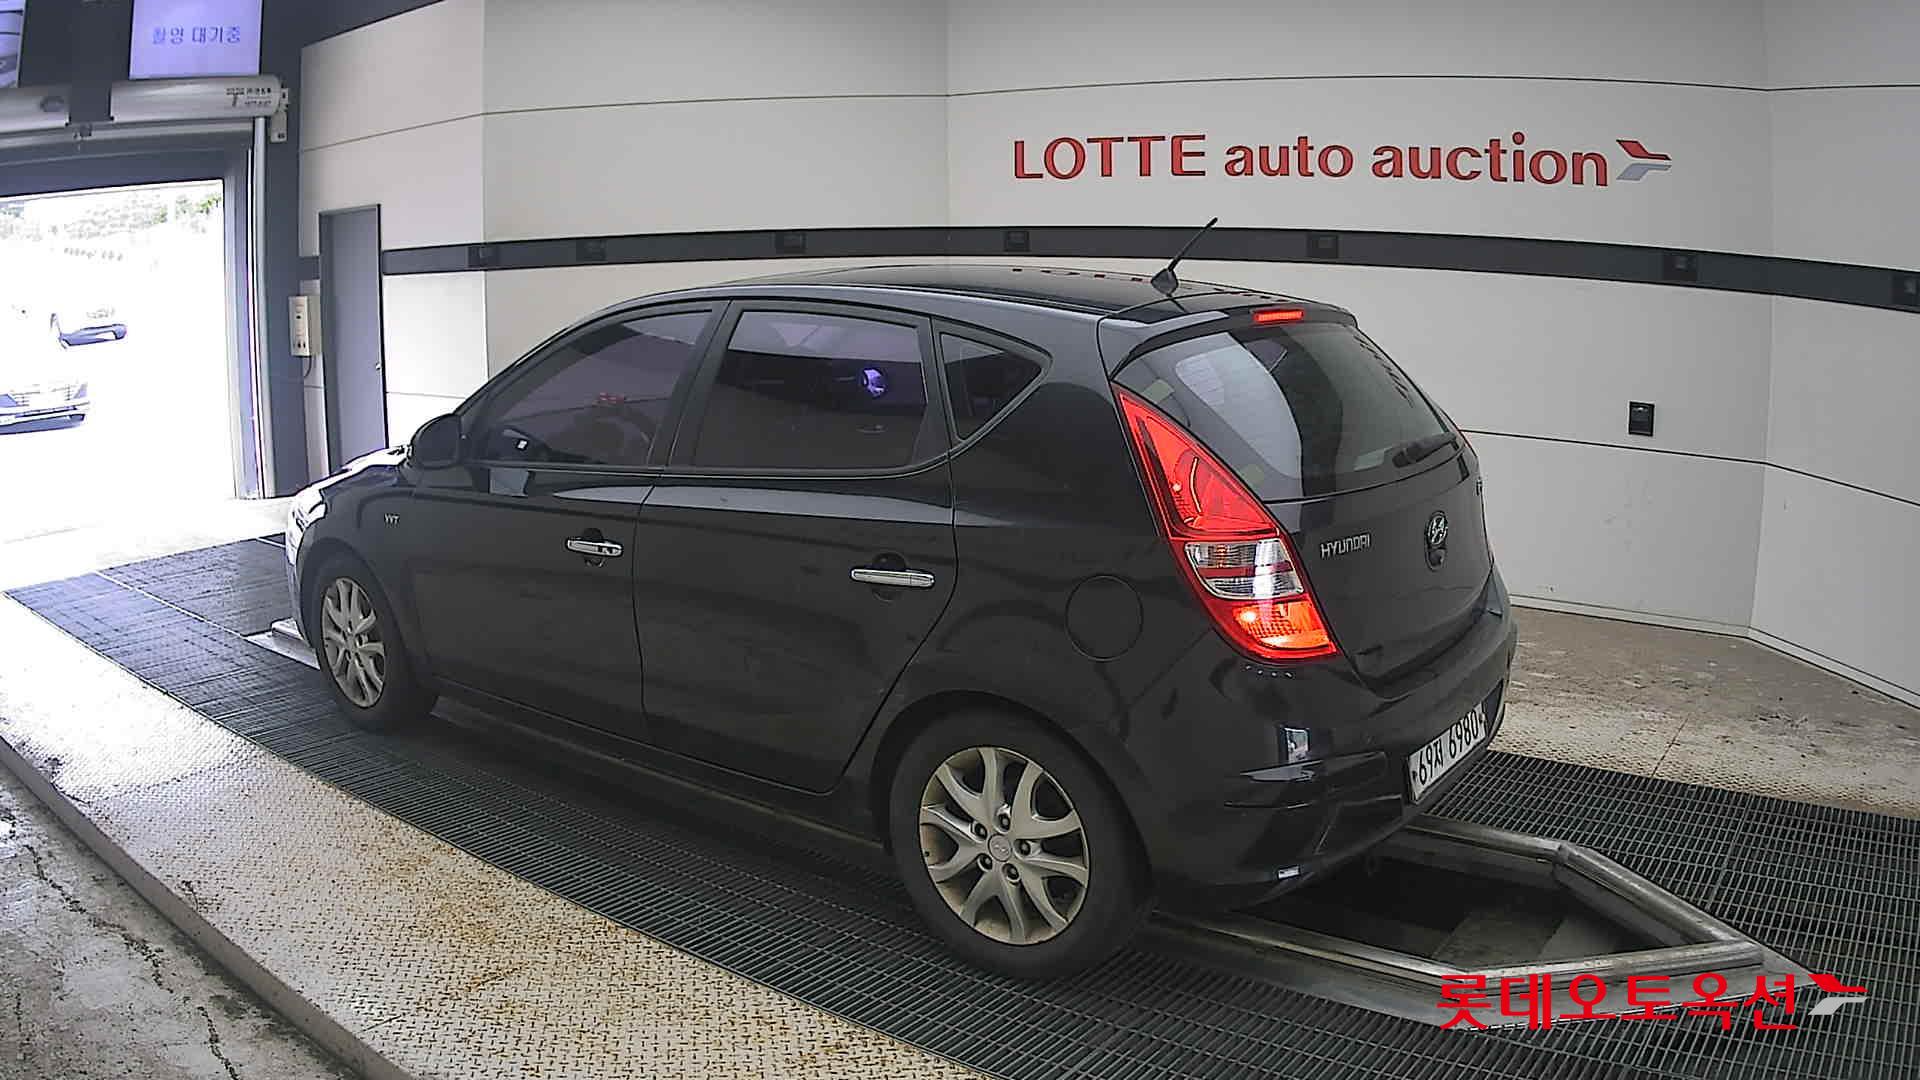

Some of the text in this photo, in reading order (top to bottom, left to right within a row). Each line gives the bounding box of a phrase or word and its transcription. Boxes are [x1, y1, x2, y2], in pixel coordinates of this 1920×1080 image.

[1014, 131, 1608, 187] LOTTE auto auction
[1320, 533, 1371, 559] HYUNDAI
[1449, 709, 1479, 759] 6980
